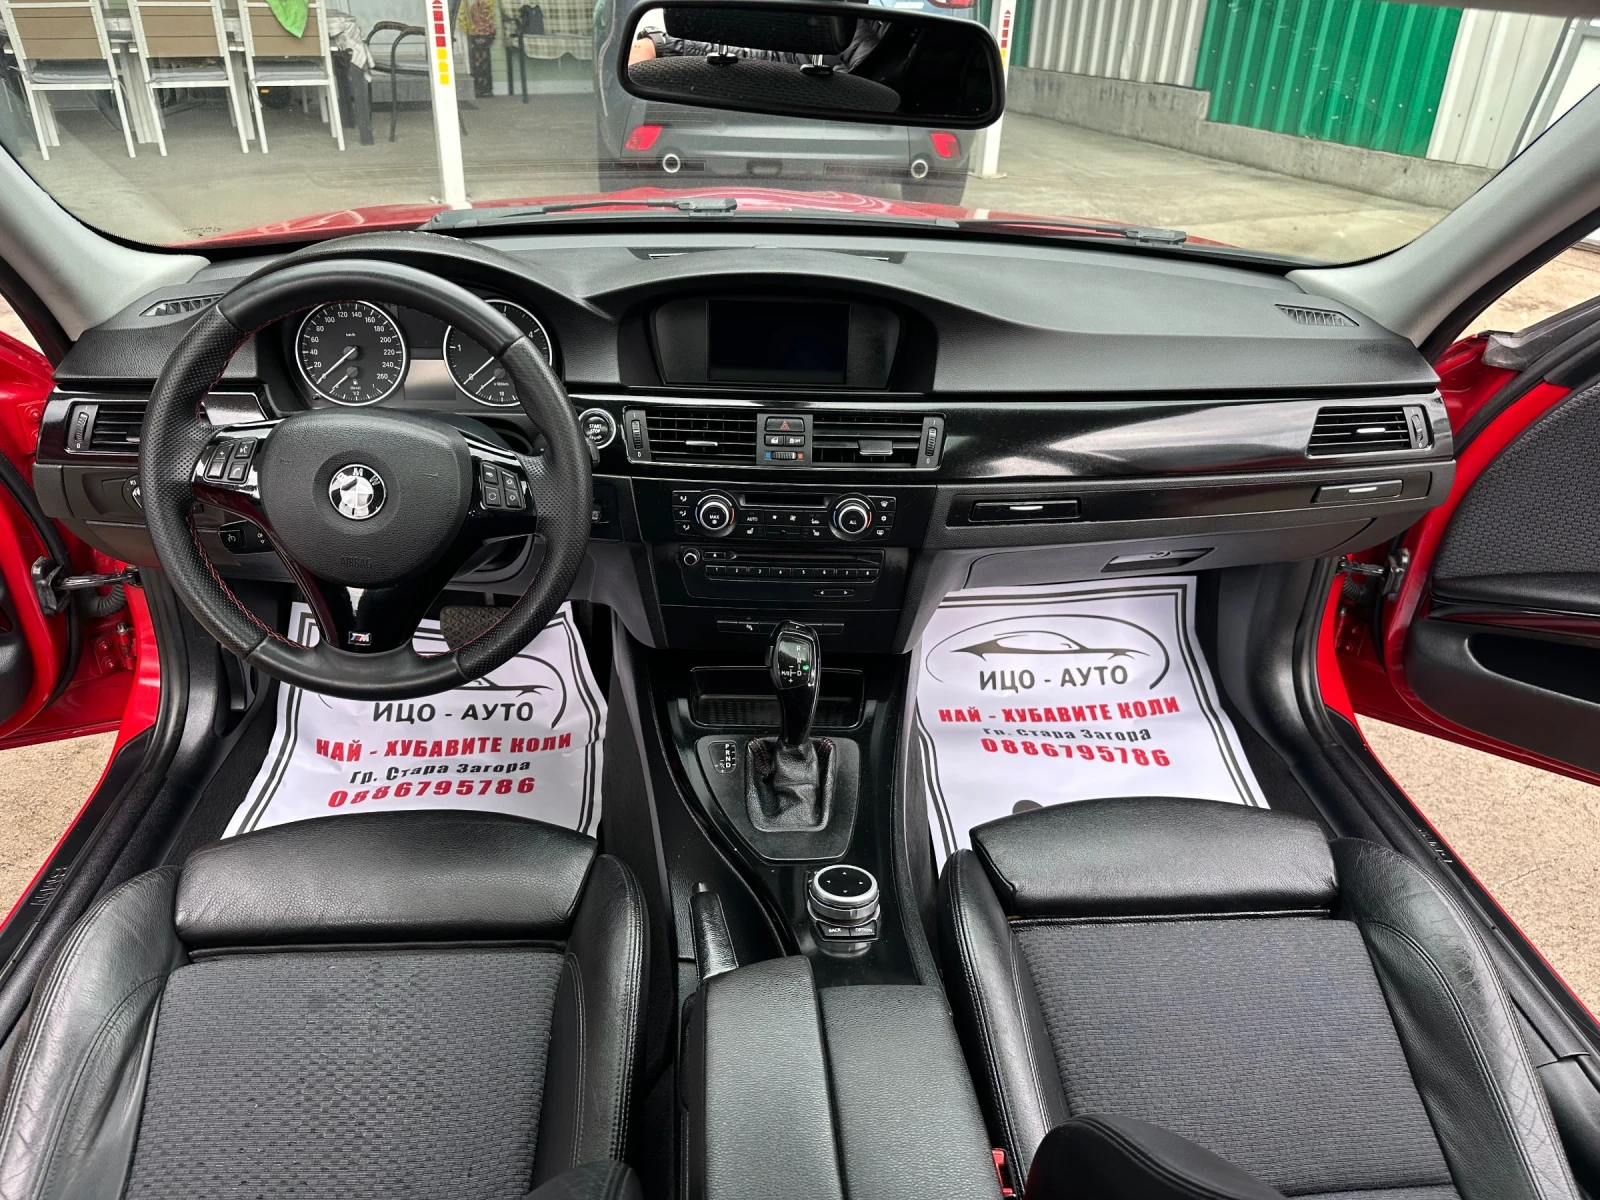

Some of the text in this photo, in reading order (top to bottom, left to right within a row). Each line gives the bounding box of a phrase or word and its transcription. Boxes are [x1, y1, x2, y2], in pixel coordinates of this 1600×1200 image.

[383, 348, 396, 356] 220
[457, 344, 462, 352] 1
[376, 372, 389, 380] 260
[979, 668, 1036, 694] ИЦО
[1060, 664, 1129, 688] АУТО
[372, 701, 437, 725] ИЦО
[460, 701, 534, 722] АУТО
[938, 705, 983, 723] НАЙ
[1001, 703, 1113, 723] ХУБАВИТЕ
[1116, 696, 1181, 720] КОЛИ
[1015, 728, 1077, 740] Стара
[1079, 727, 1152, 743] Загора
[315, 738, 363, 763] НАЙ
[383, 736, 503, 758] ХУБАВИТЕ
[509, 732, 572, 754] КОЛИ
[980, 737, 1171, 767] 0886795786
[385, 764, 450, 781] Стара
[455, 761, 531, 774] Загора
[327, 777, 536, 808] 0886795786
